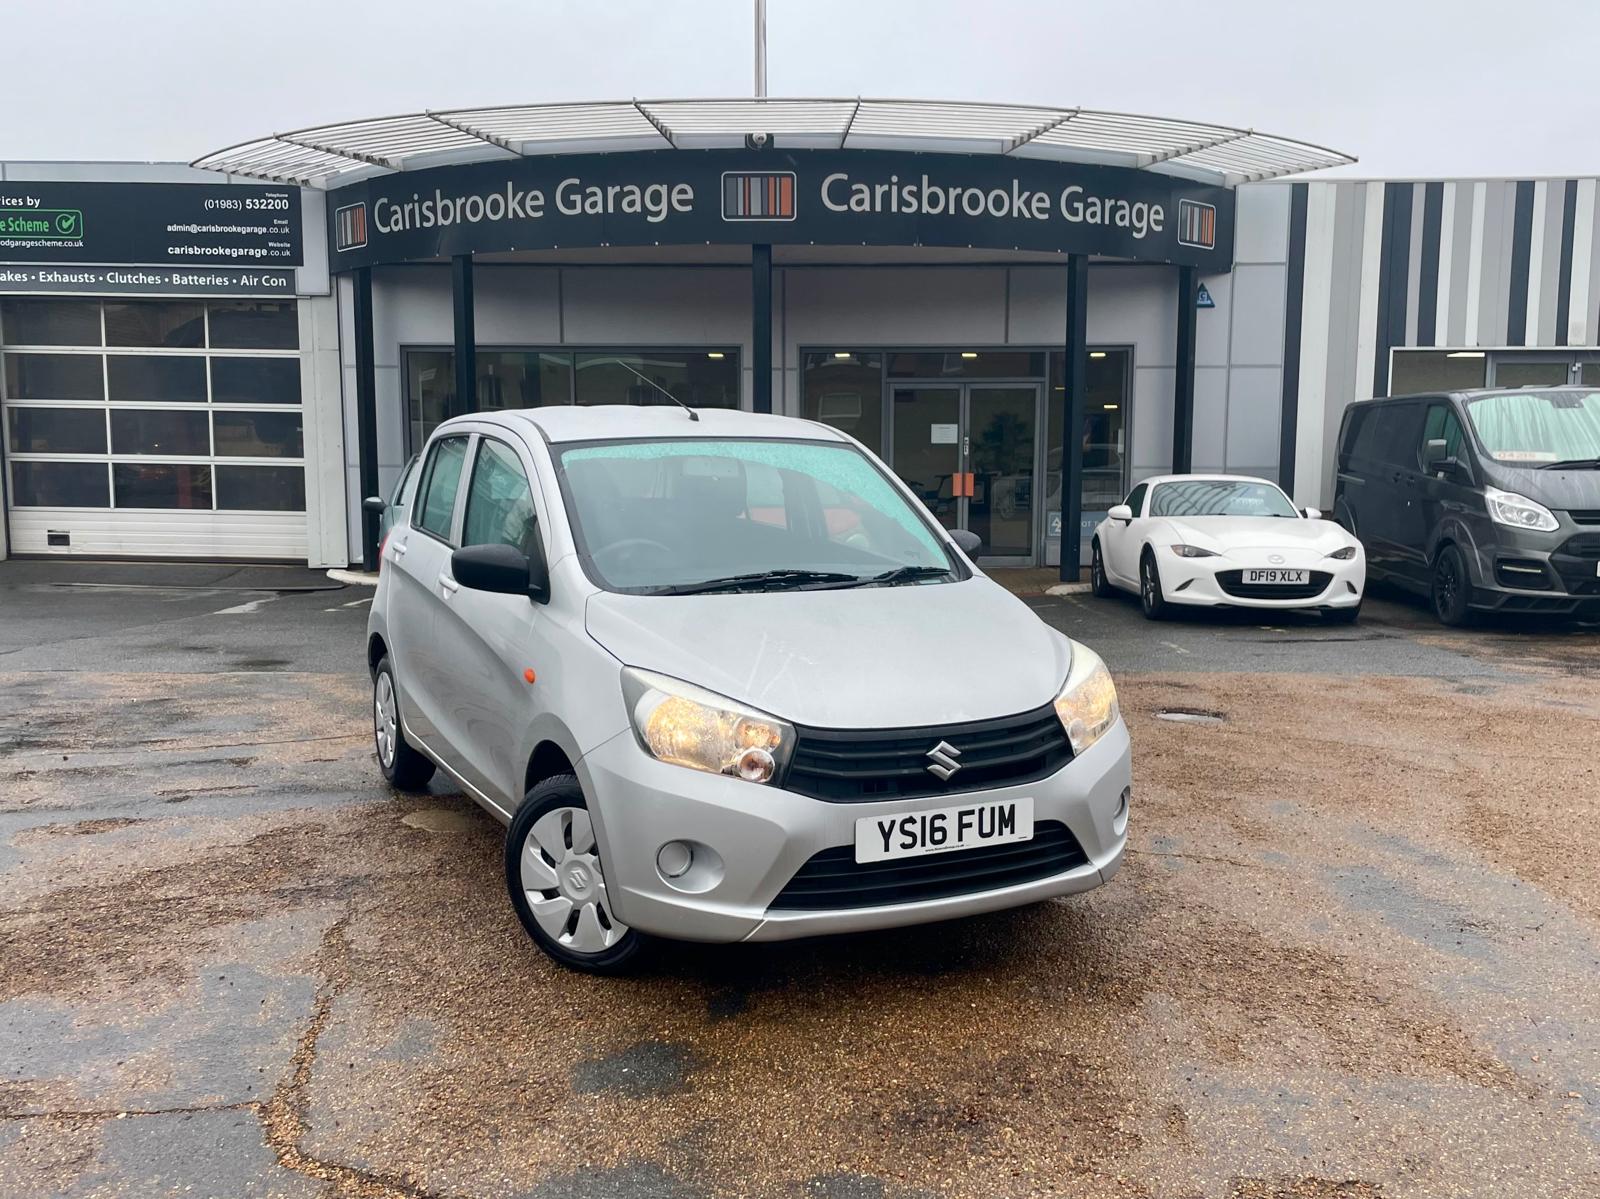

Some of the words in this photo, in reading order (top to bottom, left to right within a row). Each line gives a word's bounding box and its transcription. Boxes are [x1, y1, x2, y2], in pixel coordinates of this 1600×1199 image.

[0, 196, 24, 206] ices
[26, 195, 41, 208] by
[204, 199, 242, 211] (01983)
[245, 199, 289, 210] 532200
[374, 181, 545, 234] Carisbrooke
[555, 178, 695, 223] Garage
[820, 172, 1051, 219] Carisbrooke
[1059, 185, 1165, 239] Garage
[7, 216, 50, 232] Scheme
[167, 224, 290, 235] admin@carisbrookegarage.co.uk
[0, 239, 84, 248] odgaragescheme.co.uk
[167, 245, 291, 258] carisbrookegarage.co.uk
[39, 271, 96, 283] Exhausts
[106, 272, 162, 284] Clutches
[172, 273, 229, 286] Batteries
[240, 275, 259, 286] Air
[261, 275, 287, 287] Con
[1250, 570, 1277, 582] DF19
[1279, 570, 1303, 582] XLX
[877, 813, 948, 853] YS16
[957, 803, 1016, 843] FUM
